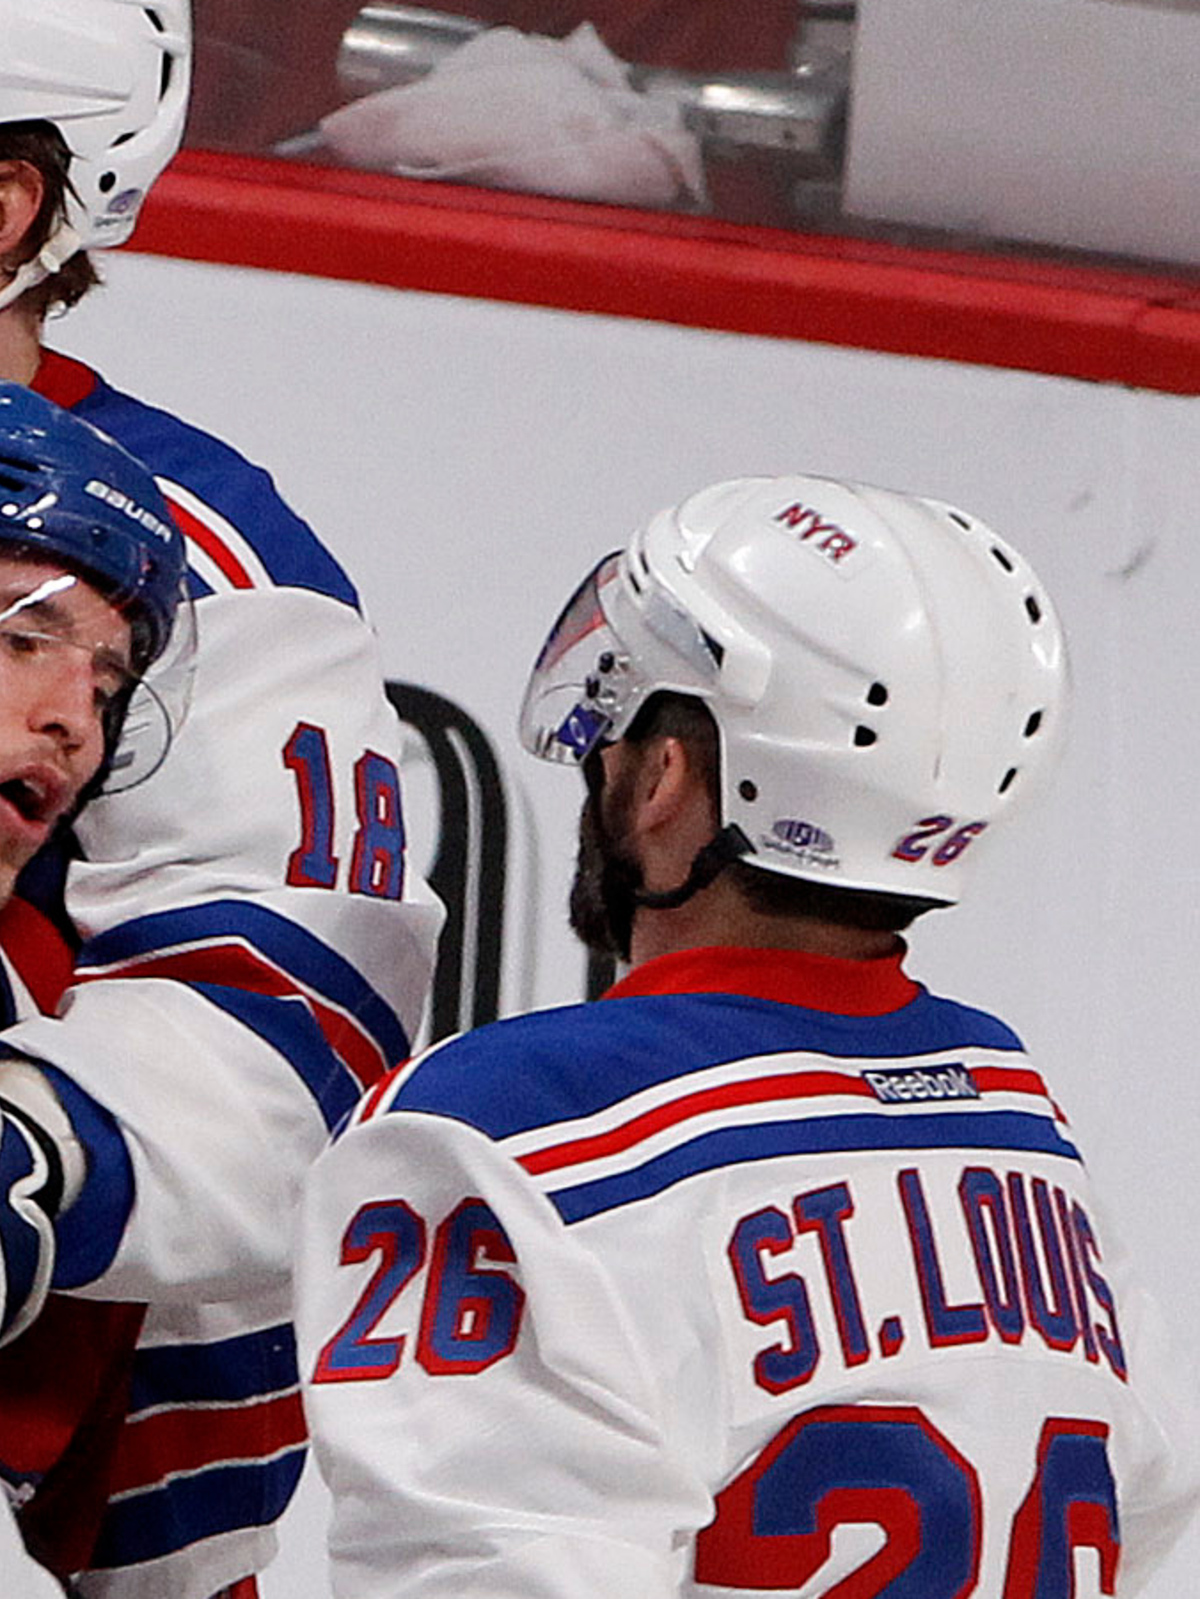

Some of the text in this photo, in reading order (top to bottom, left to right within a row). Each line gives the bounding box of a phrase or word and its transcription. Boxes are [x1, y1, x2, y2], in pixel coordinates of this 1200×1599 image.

[84, 480, 172, 543] BAUER
[774, 502, 856, 562] NYR
[282, 720, 406, 902] 18
[891, 815, 989, 867] 26
[864, 1067, 978, 1100] Reebok
[311, 1196, 526, 1384] 26
[728, 1166, 1128, 1395] ST. LOUIS
